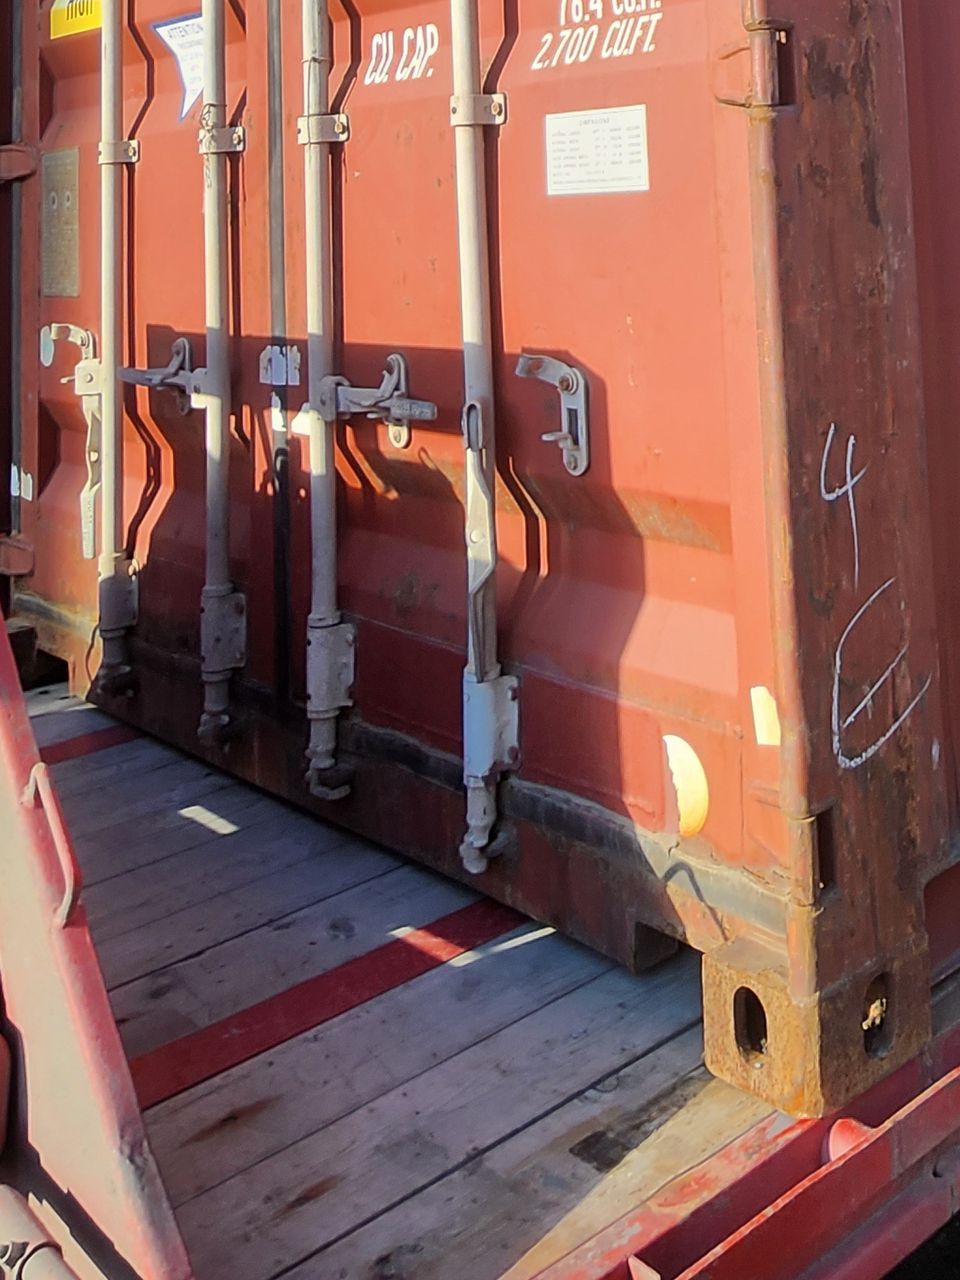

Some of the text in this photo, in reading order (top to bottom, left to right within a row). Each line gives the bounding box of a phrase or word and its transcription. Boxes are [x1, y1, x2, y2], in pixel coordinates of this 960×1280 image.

[364, 23, 440, 86] CU. CAP.
[531, 12, 663, 70] 2,700 CU.FT.
[820, 423, 870, 593] 4
